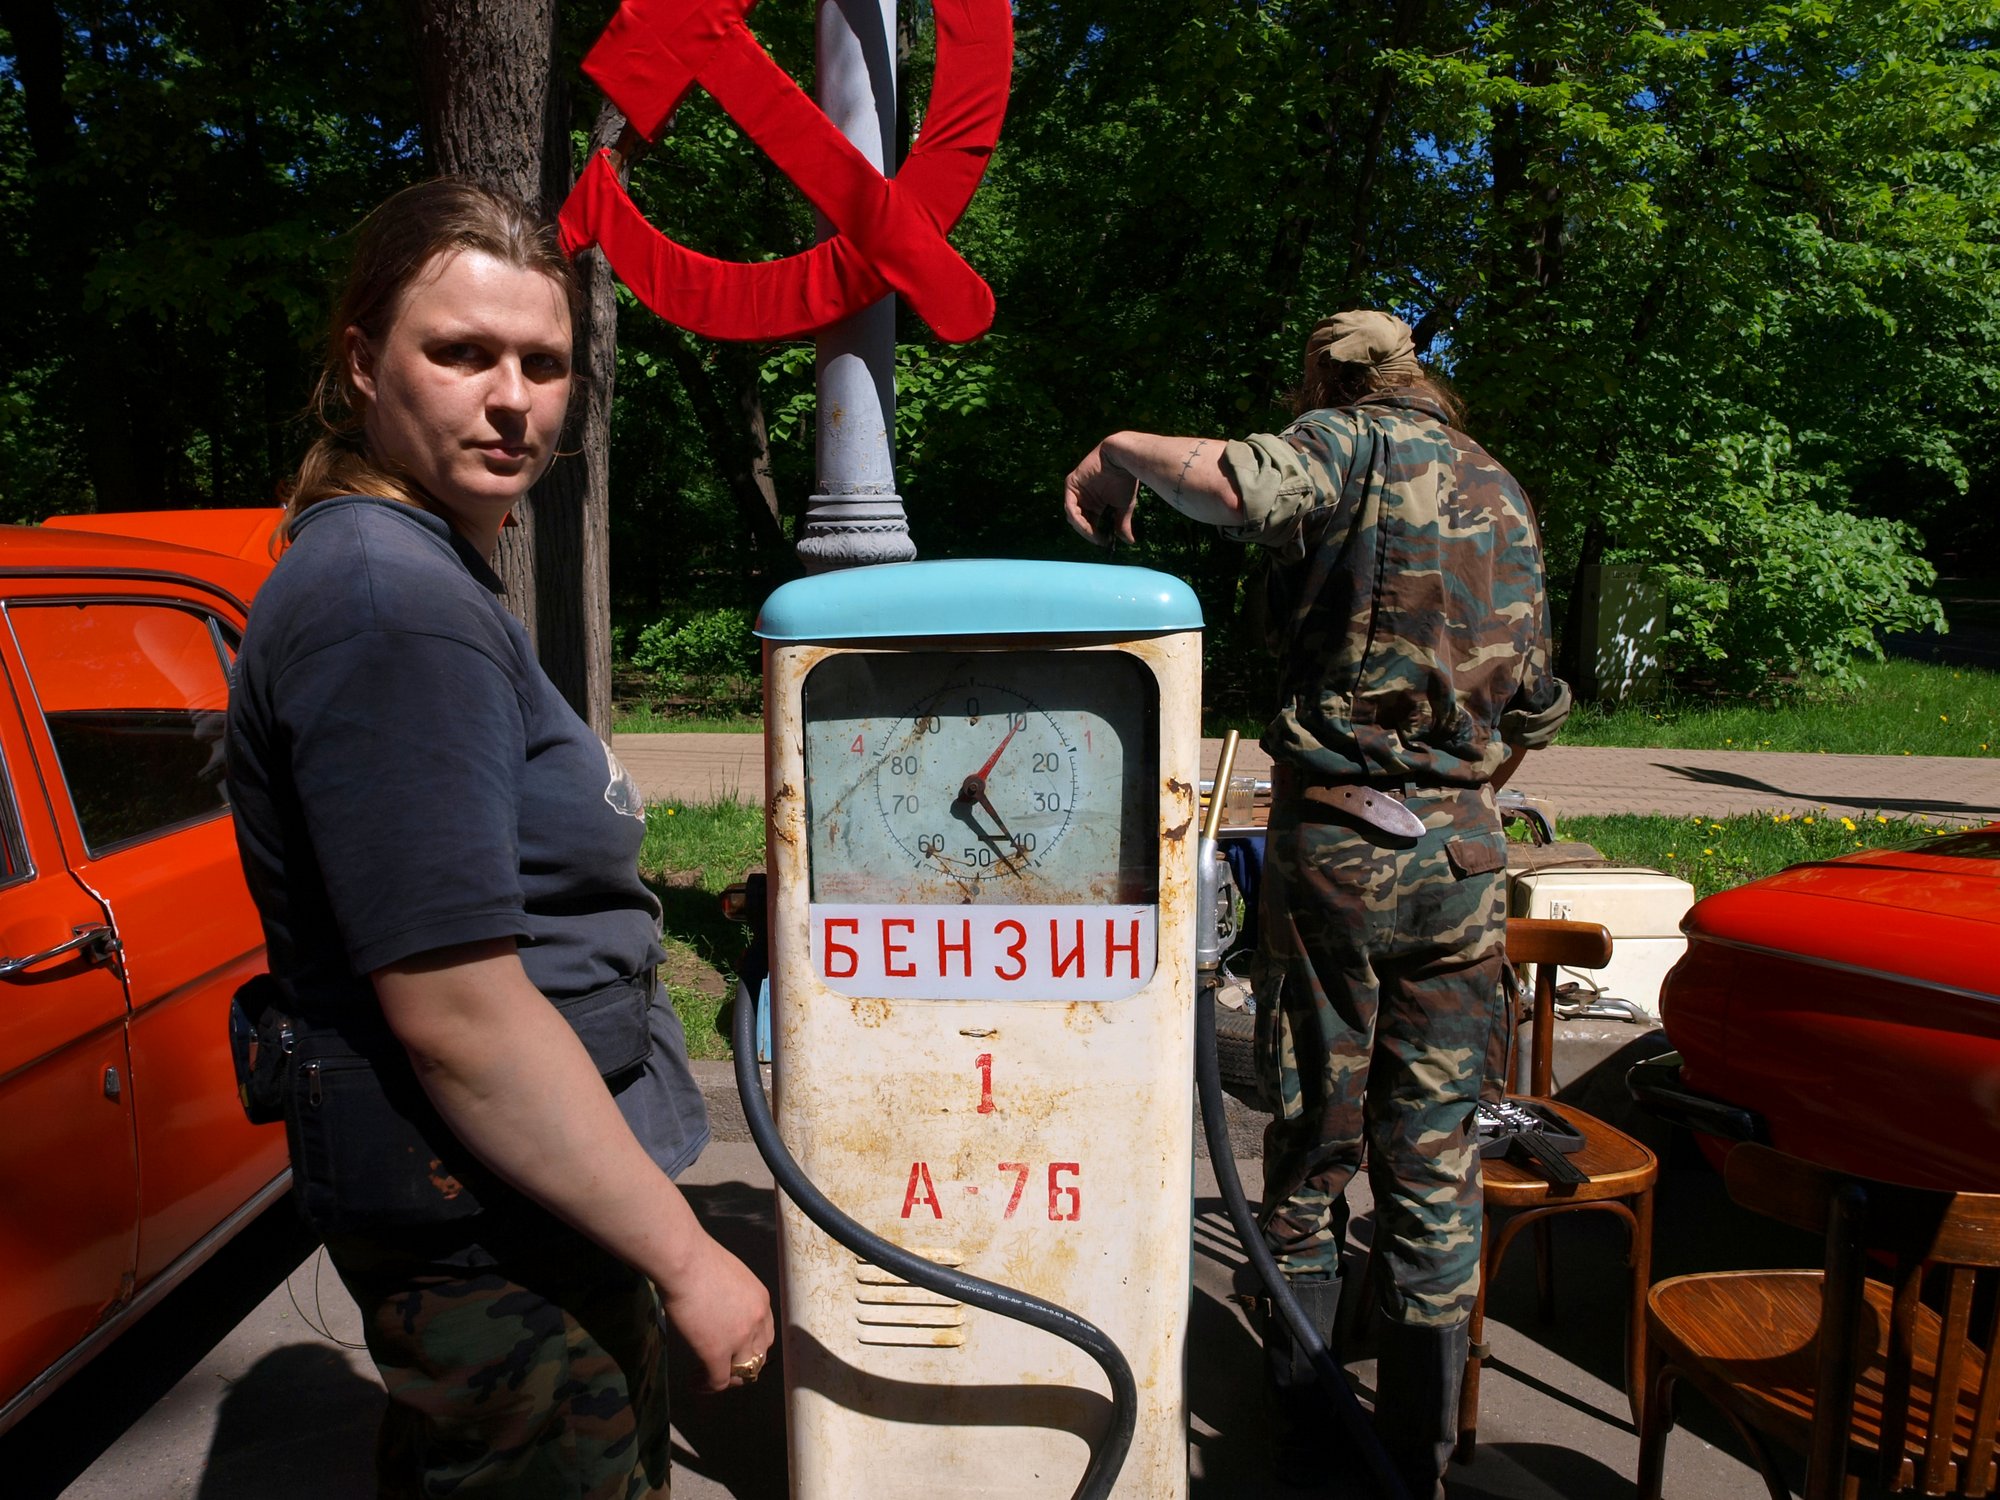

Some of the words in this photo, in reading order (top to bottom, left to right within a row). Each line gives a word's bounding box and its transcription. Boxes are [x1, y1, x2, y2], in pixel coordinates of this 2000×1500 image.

[966, 697, 979, 717] 0
[1006, 712, 1027, 732] 10
[850, 734, 865, 757] 4
[1083, 730, 1092, 753] 1
[891, 755, 918, 776] 80
[1032, 752, 1059, 773] 20
[892, 794, 919, 815] 70
[1033, 792, 1061, 812] 30
[918, 833, 945, 854] 60
[964, 848, 991, 867] 50
[824, 918, 1140, 981] БЕНЗИН
[974, 1053, 998, 1114] 1
